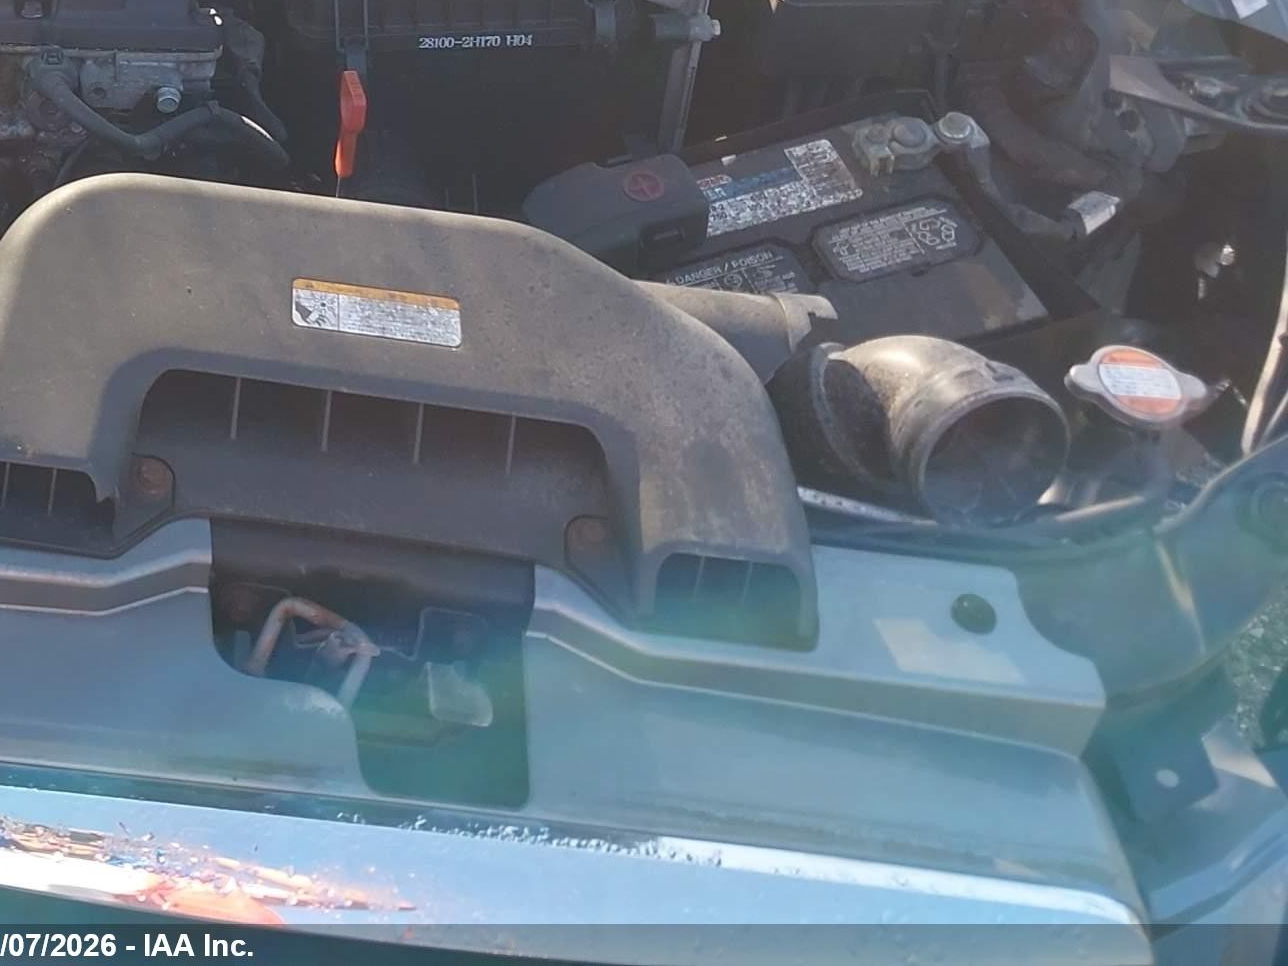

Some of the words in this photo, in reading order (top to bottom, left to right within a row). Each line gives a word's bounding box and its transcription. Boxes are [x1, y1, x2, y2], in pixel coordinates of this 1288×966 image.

[418, 34, 501, 49] 28100-2H170
[675, 265, 723, 285] DANGER
[730, 249, 775, 270] POISON
